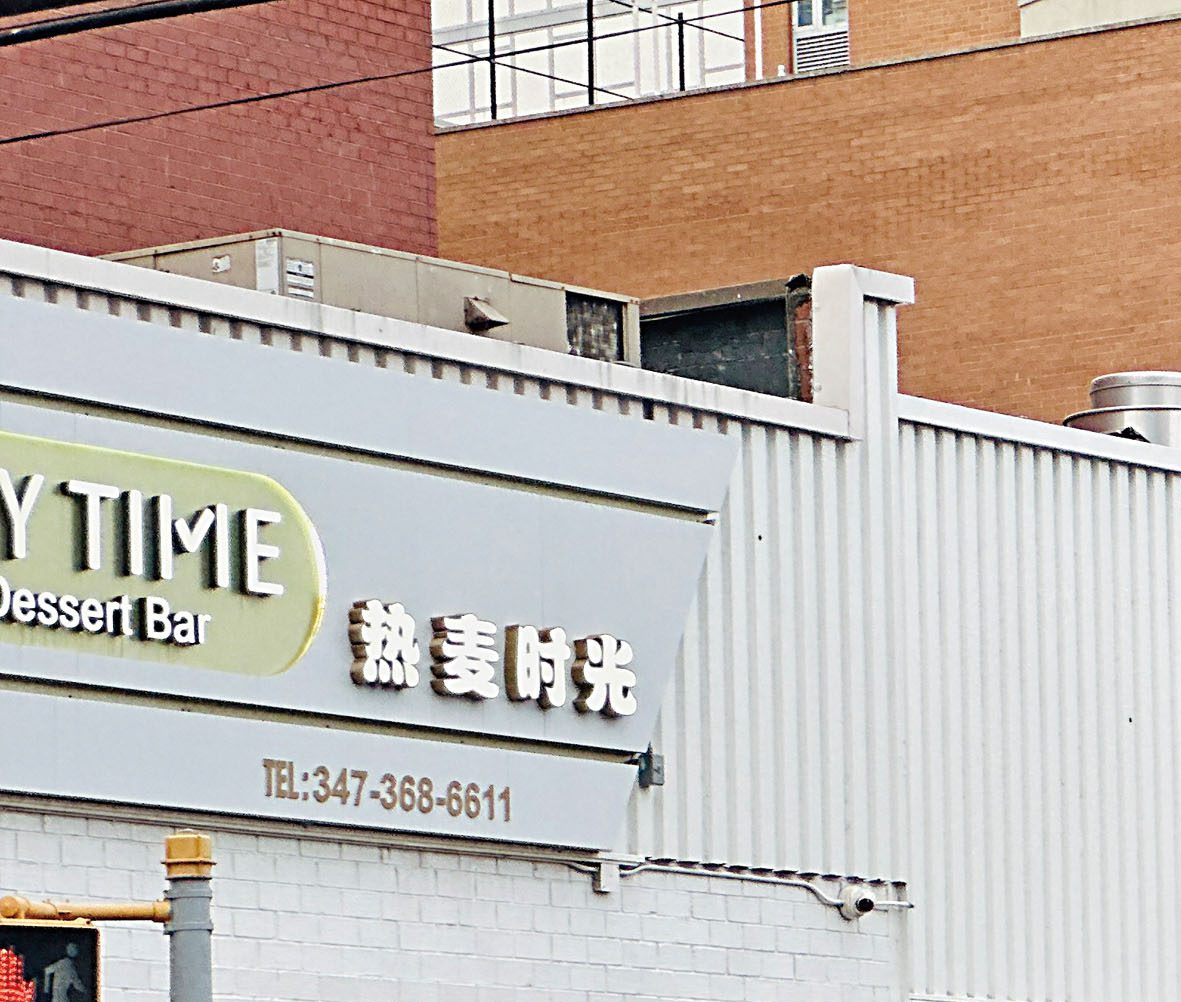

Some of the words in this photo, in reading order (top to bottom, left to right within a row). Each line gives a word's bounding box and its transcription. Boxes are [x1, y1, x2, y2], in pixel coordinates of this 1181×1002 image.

[0, 468, 44, 560] Y
[64, 480, 284, 597] TIME
[146, 596, 212, 645] Bar
[350, 600, 638, 717] 热麦时光
[263, 758, 513, 823] TEL:347-368-6611
